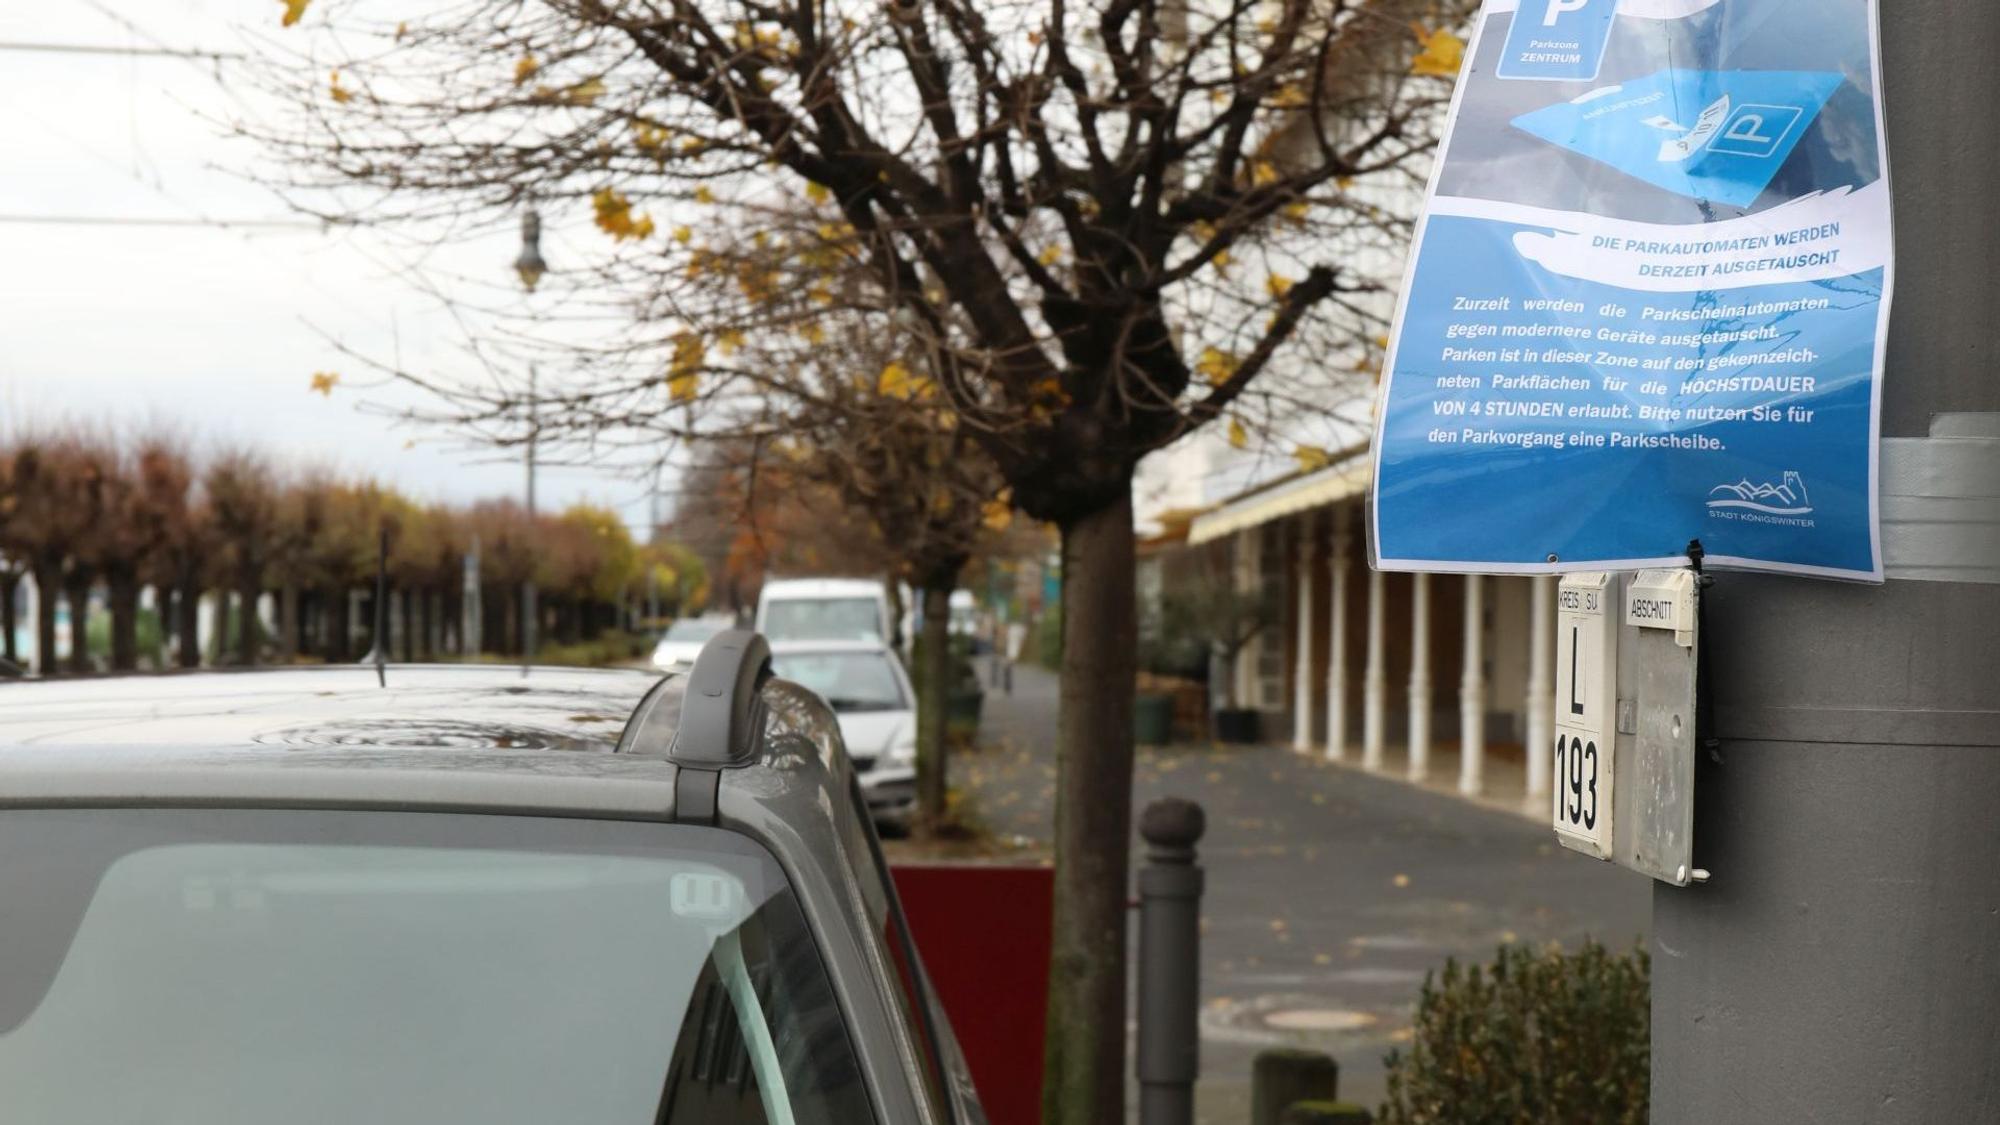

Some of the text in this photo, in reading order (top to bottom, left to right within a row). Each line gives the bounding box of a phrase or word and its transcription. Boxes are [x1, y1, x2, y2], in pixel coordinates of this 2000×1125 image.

[1529, 40, 1579, 49] Parkzone
[1520, 53, 1581, 63] ZENTRUM
[1724, 114, 1771, 143] P
[1592, 222, 1840, 255] DIE PARKAUTOMATEN WERDEN
[1638, 249, 1840, 277] DERZEIT AUSGETAUSCHT
[1453, 297, 1829, 321] Zurzeit werden die Parkscheinautomaten
[1446, 323, 1780, 347] gegen modernere Geräte ausgetauscht.
[1442, 347, 1819, 371] Parken ist in dieser Zone auf den gekennzeich-
[1436, 374, 1816, 395] neten Parkflächen für die HÖCHSTDAUER
[1433, 401, 1814, 423] VON 4 STUNDEN erlaubt. Bitte nutzen Sie für
[1428, 428, 1726, 450] den Parkvorgang eine Parkscheibe.
[1709, 510, 1815, 528] STADT KÖNIGSWINTER
[1559, 590, 1598, 611] KREIS SU
[1631, 598, 1673, 621] ABSCHNITT
[1571, 626, 1584, 715] L
[1557, 734, 1598, 831] 193
